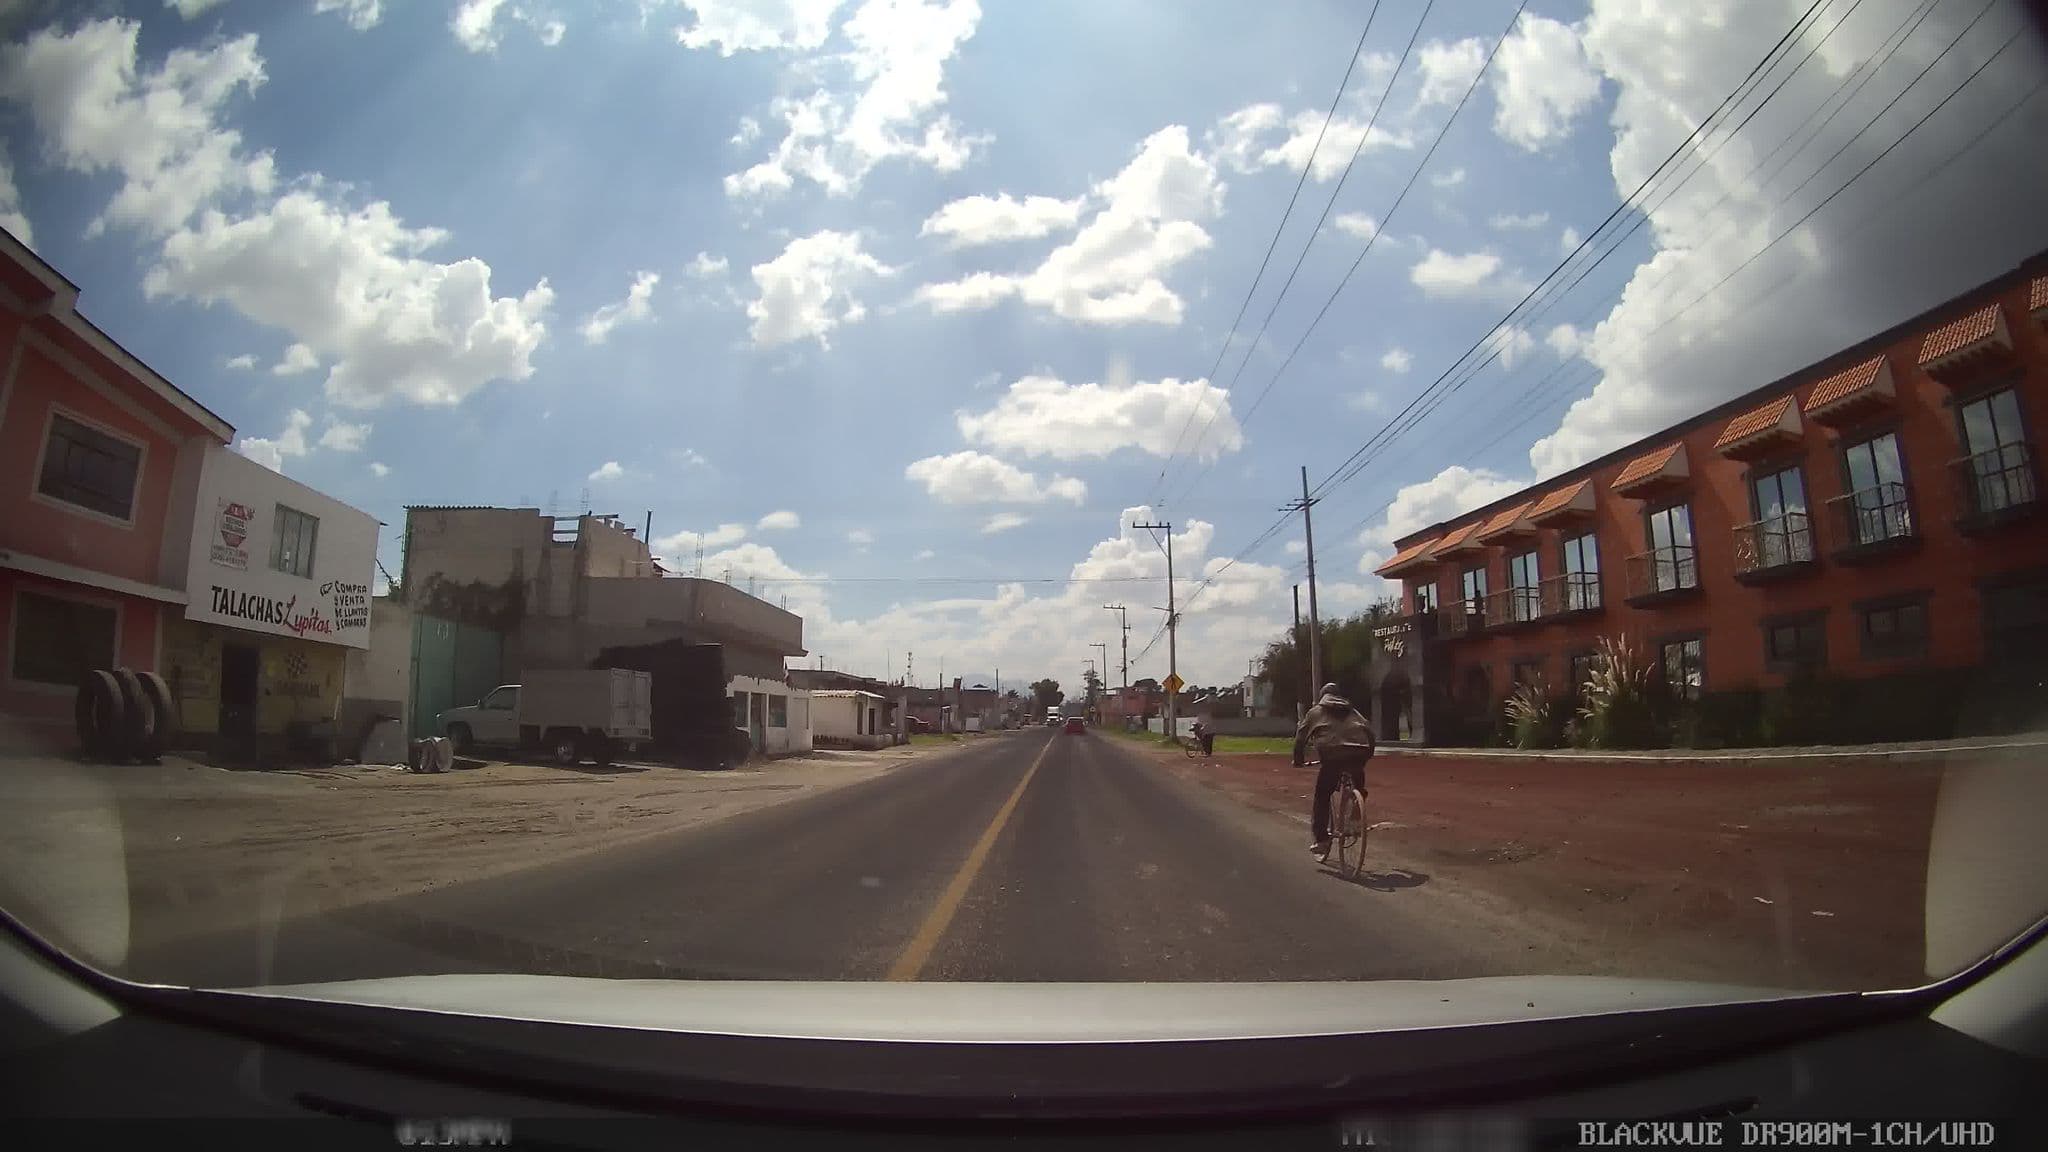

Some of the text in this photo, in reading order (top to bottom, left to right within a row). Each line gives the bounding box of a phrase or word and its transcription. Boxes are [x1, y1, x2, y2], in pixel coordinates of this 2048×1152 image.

[334, 580, 367, 594] COMPRA
[211, 584, 283, 626] TALACHAS
[339, 595, 365, 606] VENTA
[335, 607, 368, 618] DE LLANTAS
